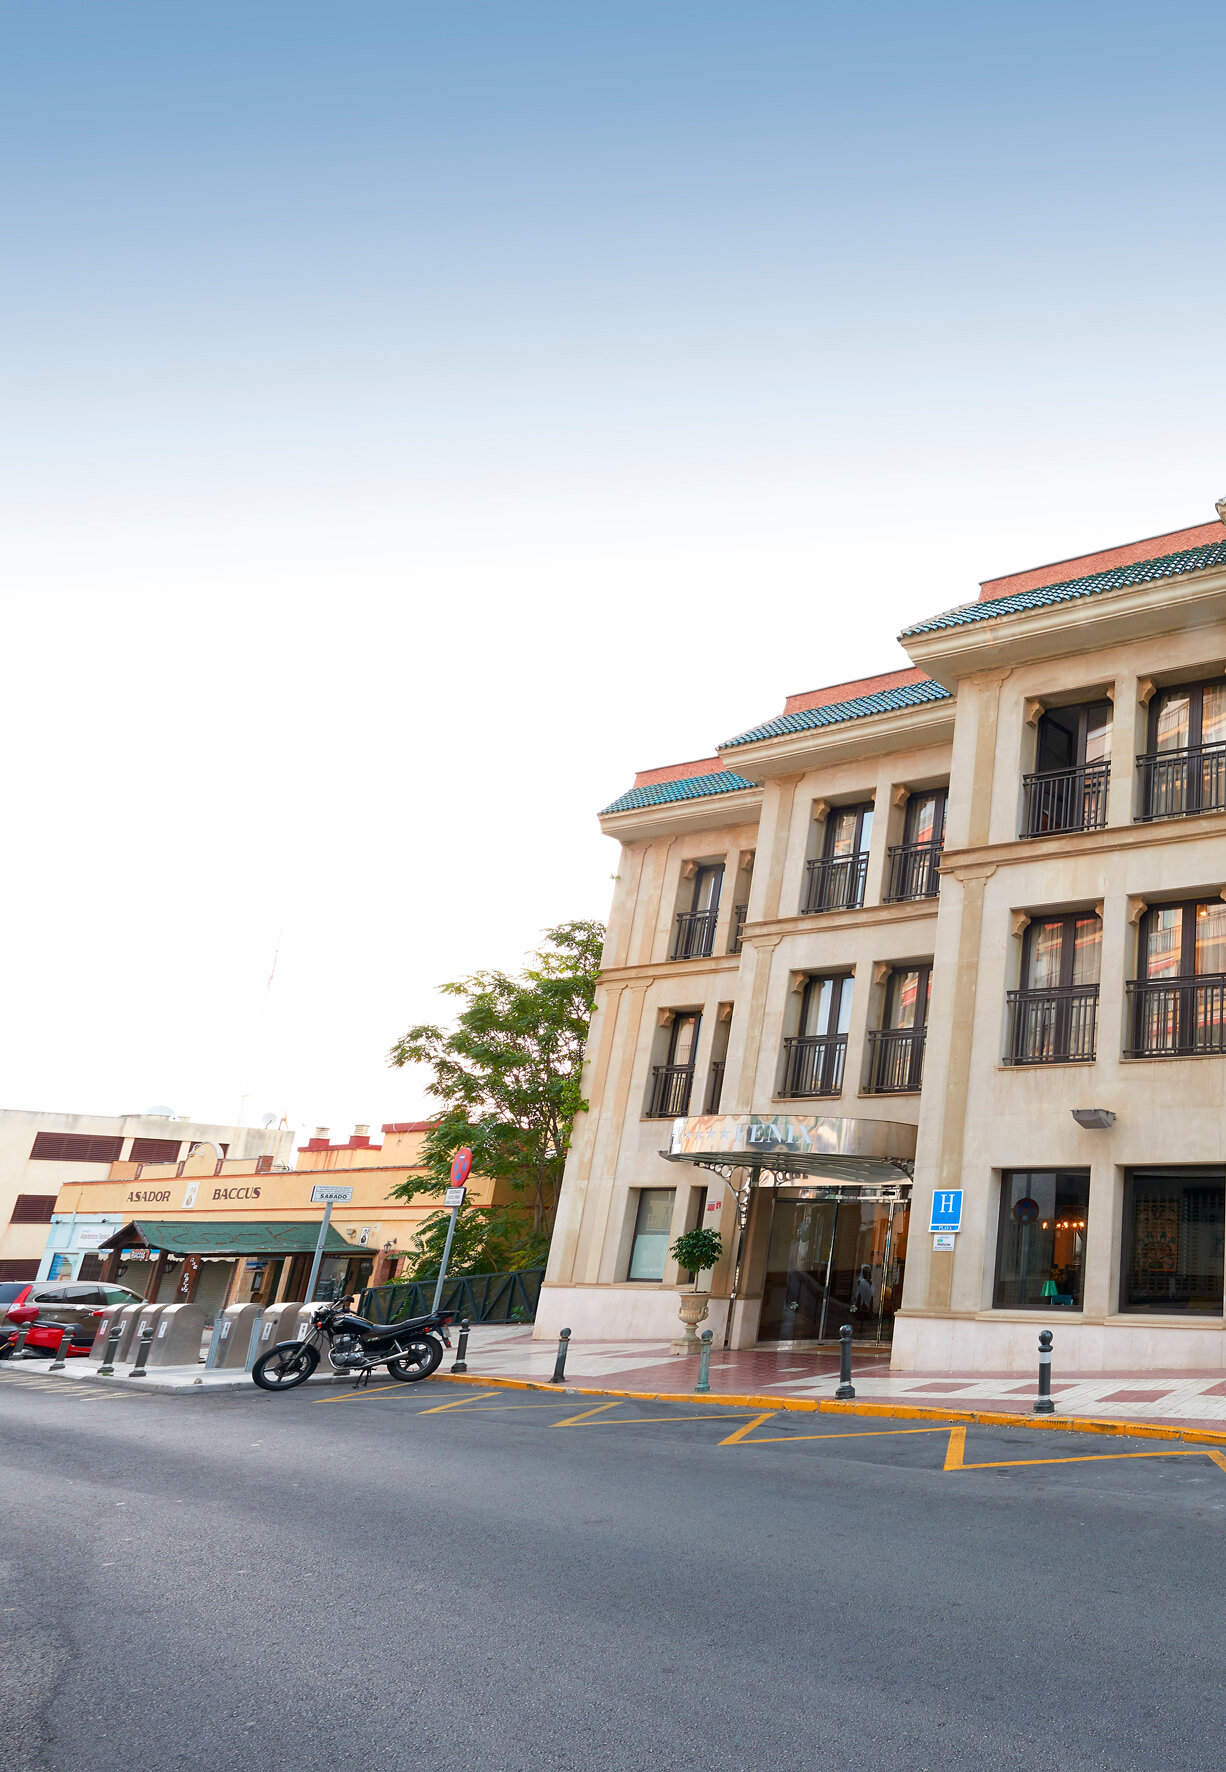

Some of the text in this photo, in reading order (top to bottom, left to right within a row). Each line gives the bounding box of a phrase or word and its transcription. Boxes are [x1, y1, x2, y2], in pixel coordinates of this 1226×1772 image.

[735, 1123, 813, 1144] FENIX
[126, 1190, 171, 1203] ASADOR
[212, 1186, 261, 1201] BACCUS
[939, 1194, 956, 1213] H
